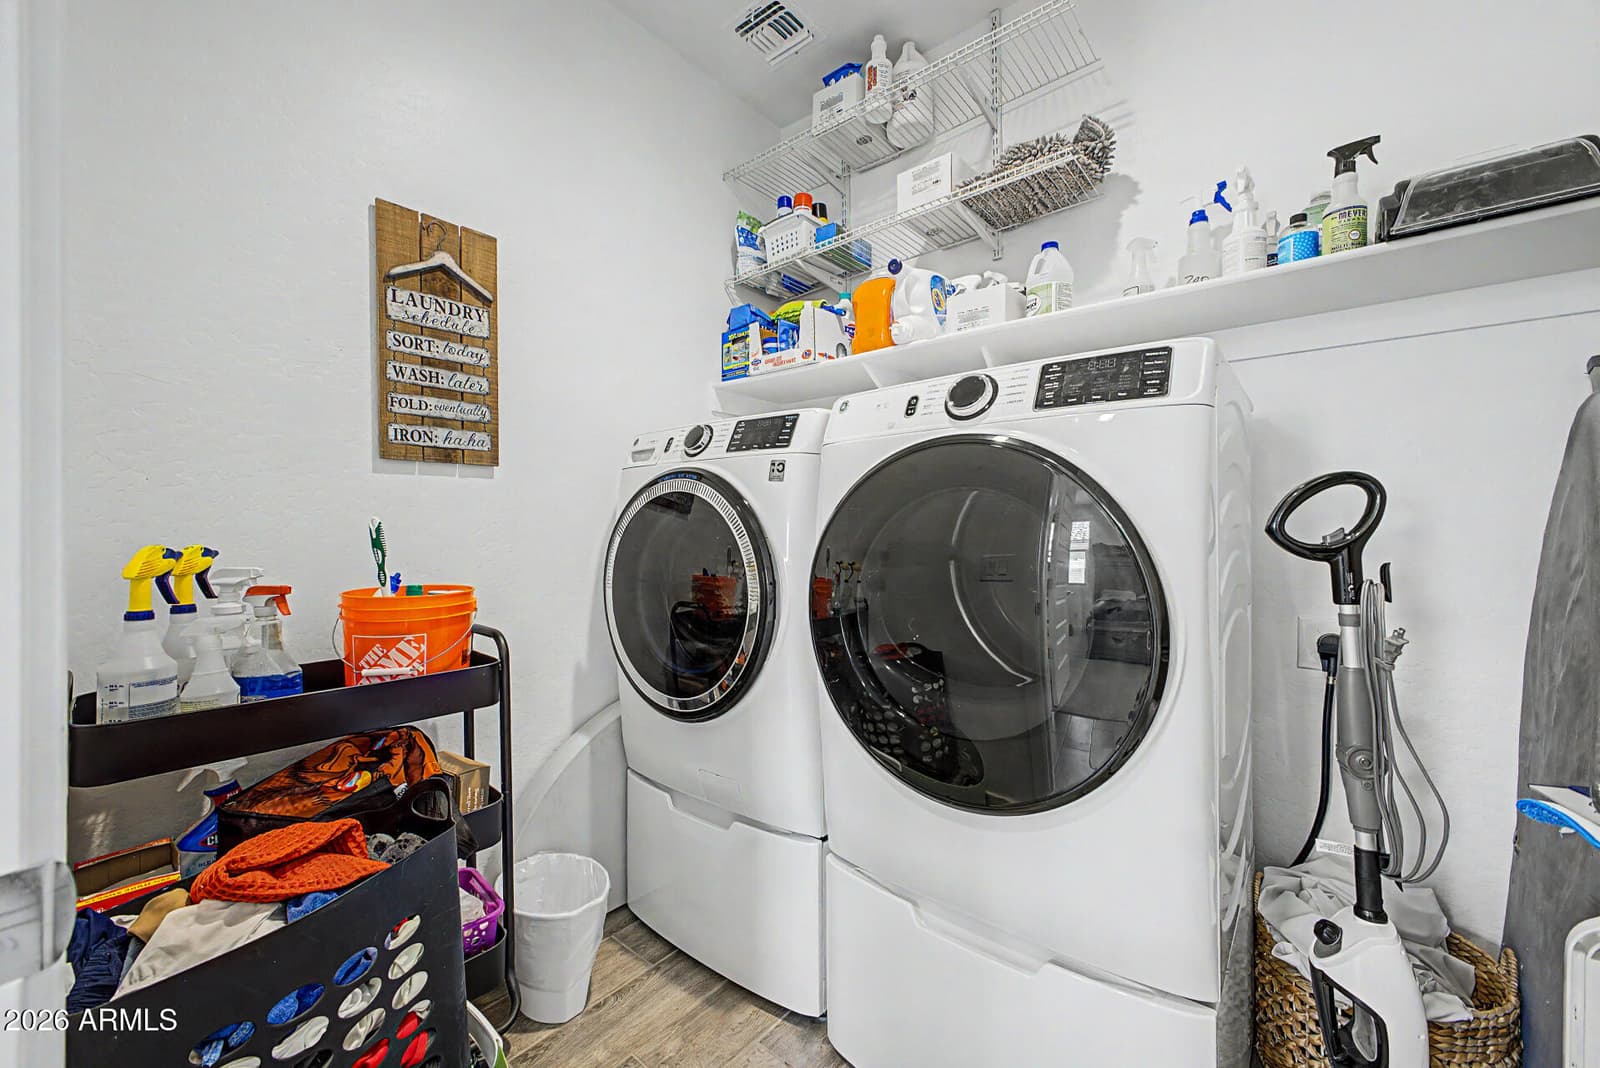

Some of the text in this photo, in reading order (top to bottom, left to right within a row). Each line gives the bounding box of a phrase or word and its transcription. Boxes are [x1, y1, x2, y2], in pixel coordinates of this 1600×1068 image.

[391, 288, 485, 323] LAUNDRY
[402, 310, 476, 334] schedule
[392, 334, 486, 364] SORT: today
[392, 365, 485, 393] WASH: later
[389, 396, 488, 421] FOLD: eventually
[392, 428, 438, 444] IRON:
[359, 643, 388, 669] THE
